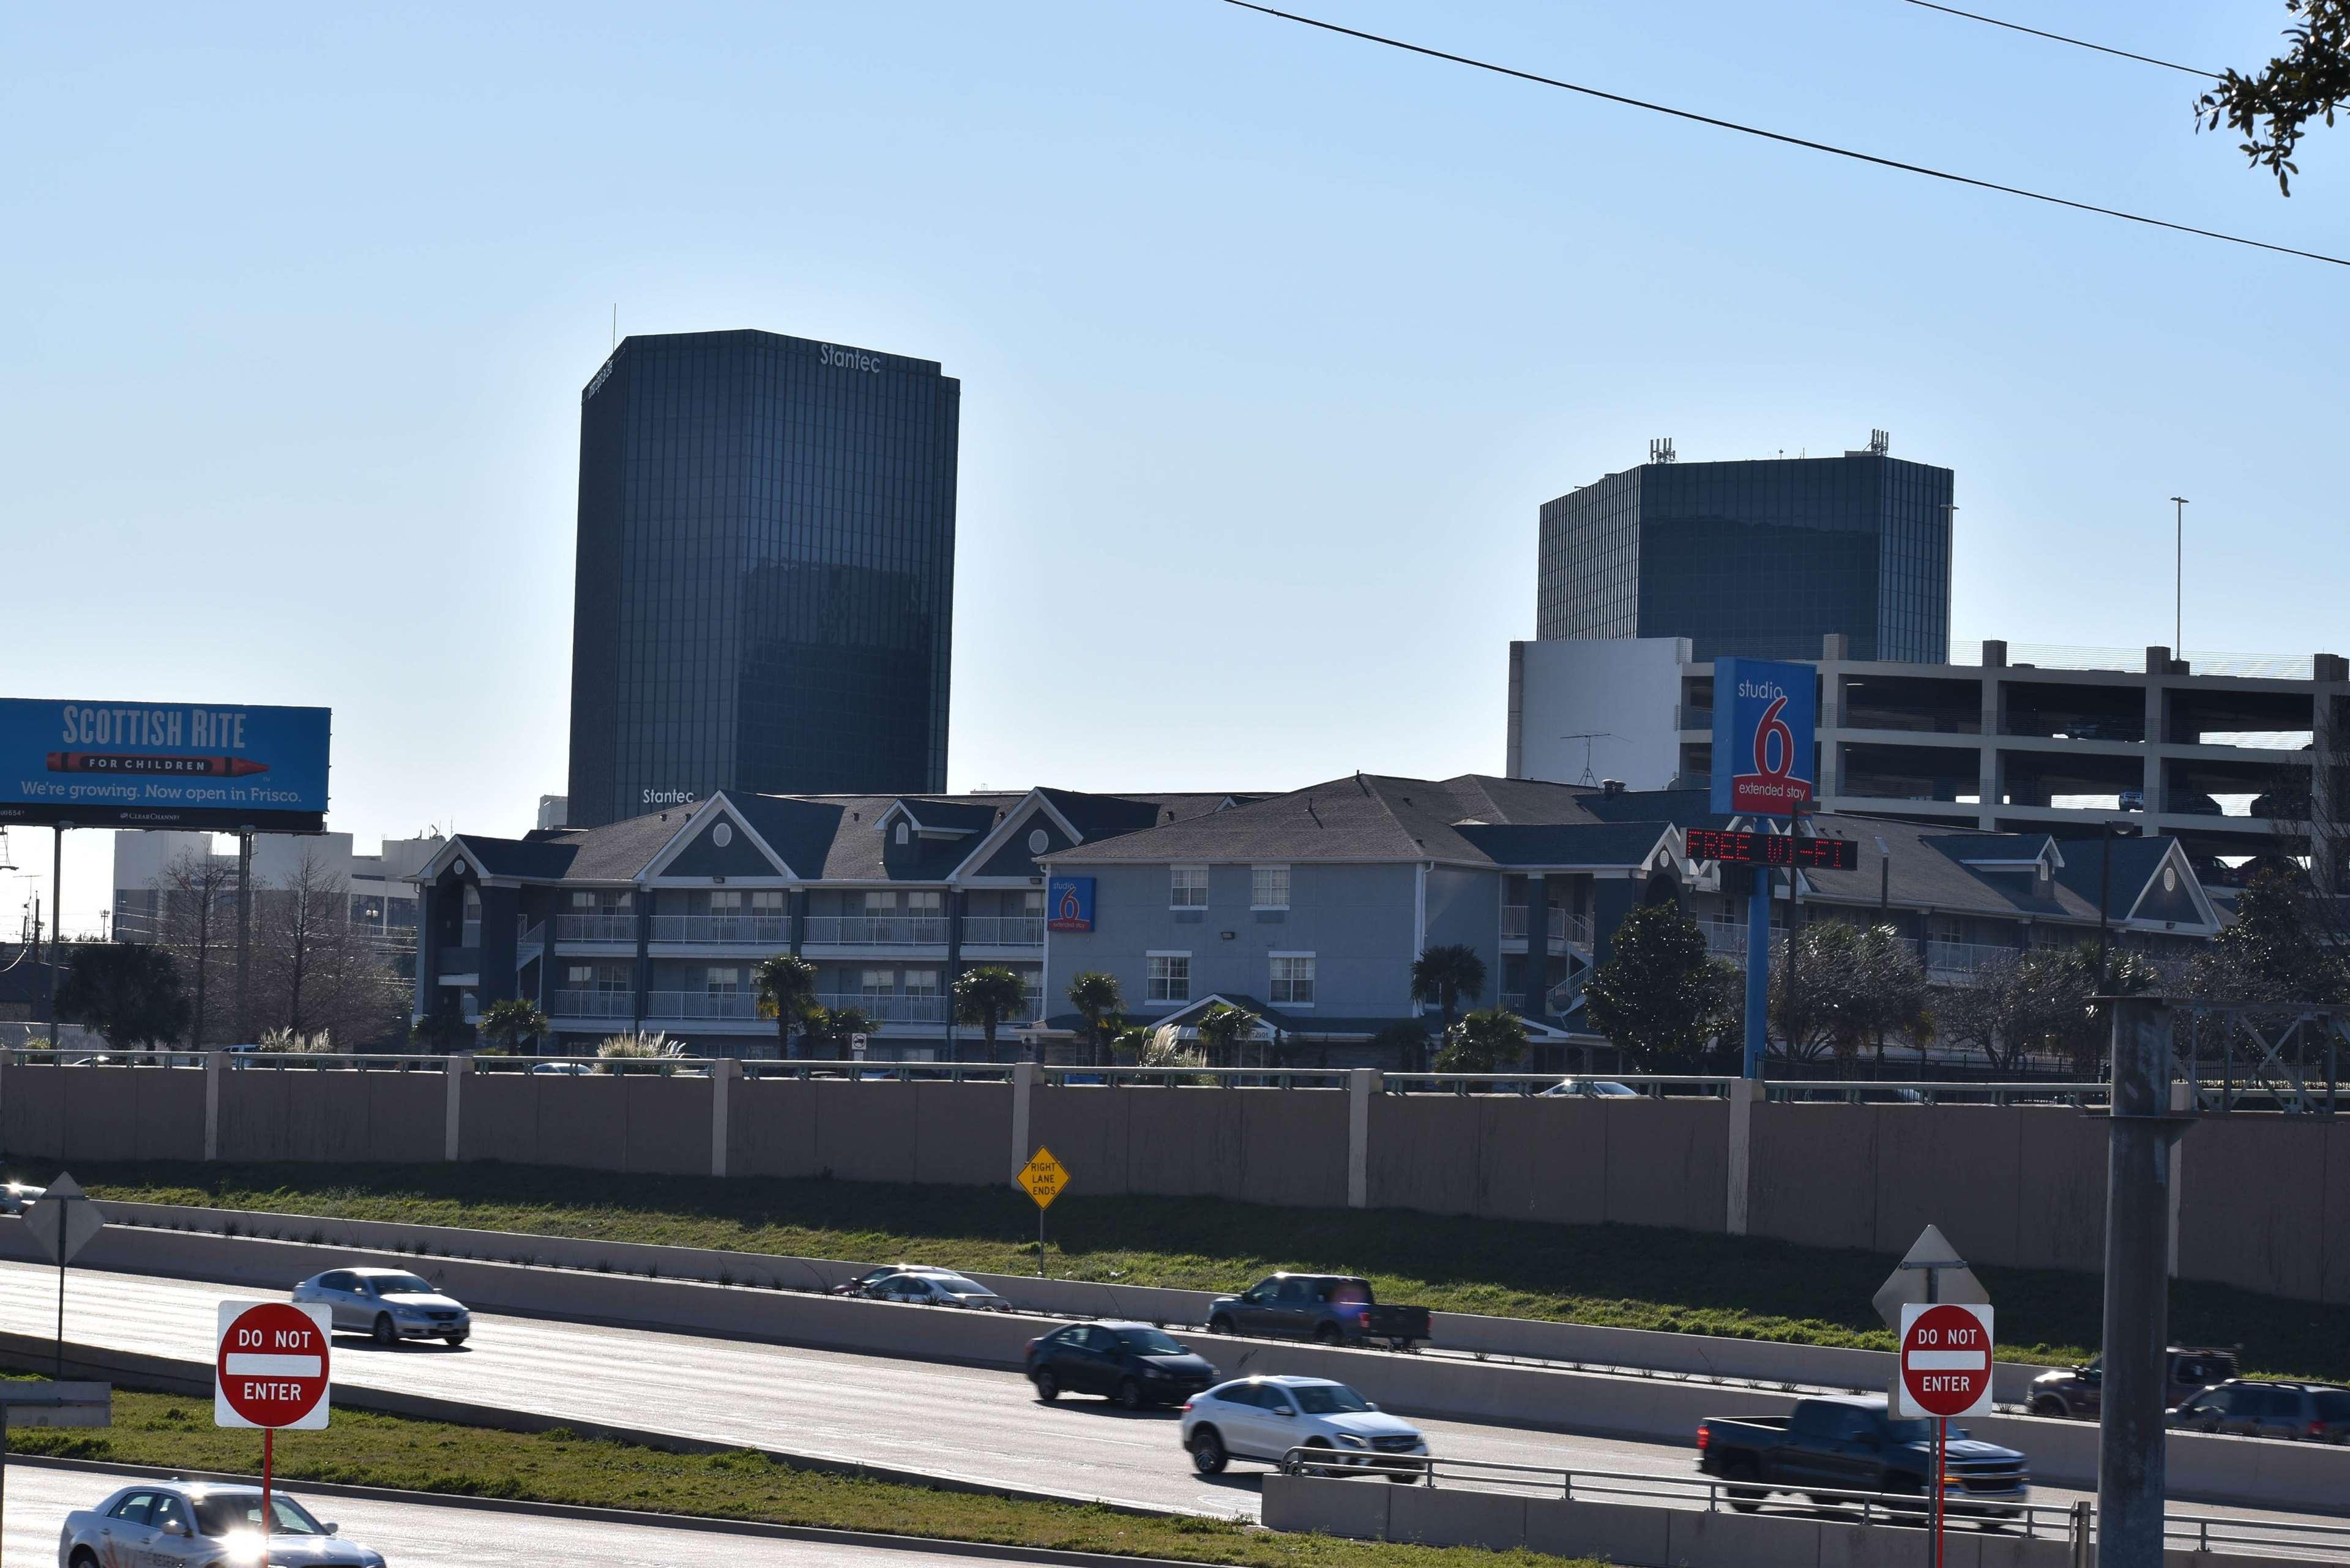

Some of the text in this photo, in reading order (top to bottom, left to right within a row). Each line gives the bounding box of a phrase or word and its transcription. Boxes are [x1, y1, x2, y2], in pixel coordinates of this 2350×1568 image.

[821, 343, 881, 373] Stantec
[1739, 679, 1783, 700] studio
[62, 705, 247, 748] SCOTTISH RITE
[1754, 695, 1794, 777] 6
[89, 759, 205, 771] FOR CHILDREN
[21, 780, 302, 802] We're growing. Now open in Frisco.
[643, 788, 694, 803] Stantec
[1739, 782, 1806, 801] extended stay
[1688, 831, 1843, 867] FREE WI-FI
[1059, 886, 1080, 920] 6
[1031, 1163, 1057, 1171] RIGHT
[1032, 1174, 1054, 1183] LANE
[1033, 1187, 1056, 1195] ENDS
[239, 1329, 311, 1348] DO NOT
[1918, 1329, 1977, 1345] DO NOT
[244, 1382, 301, 1401] ENTER
[1923, 1376, 1970, 1392] ENTER
